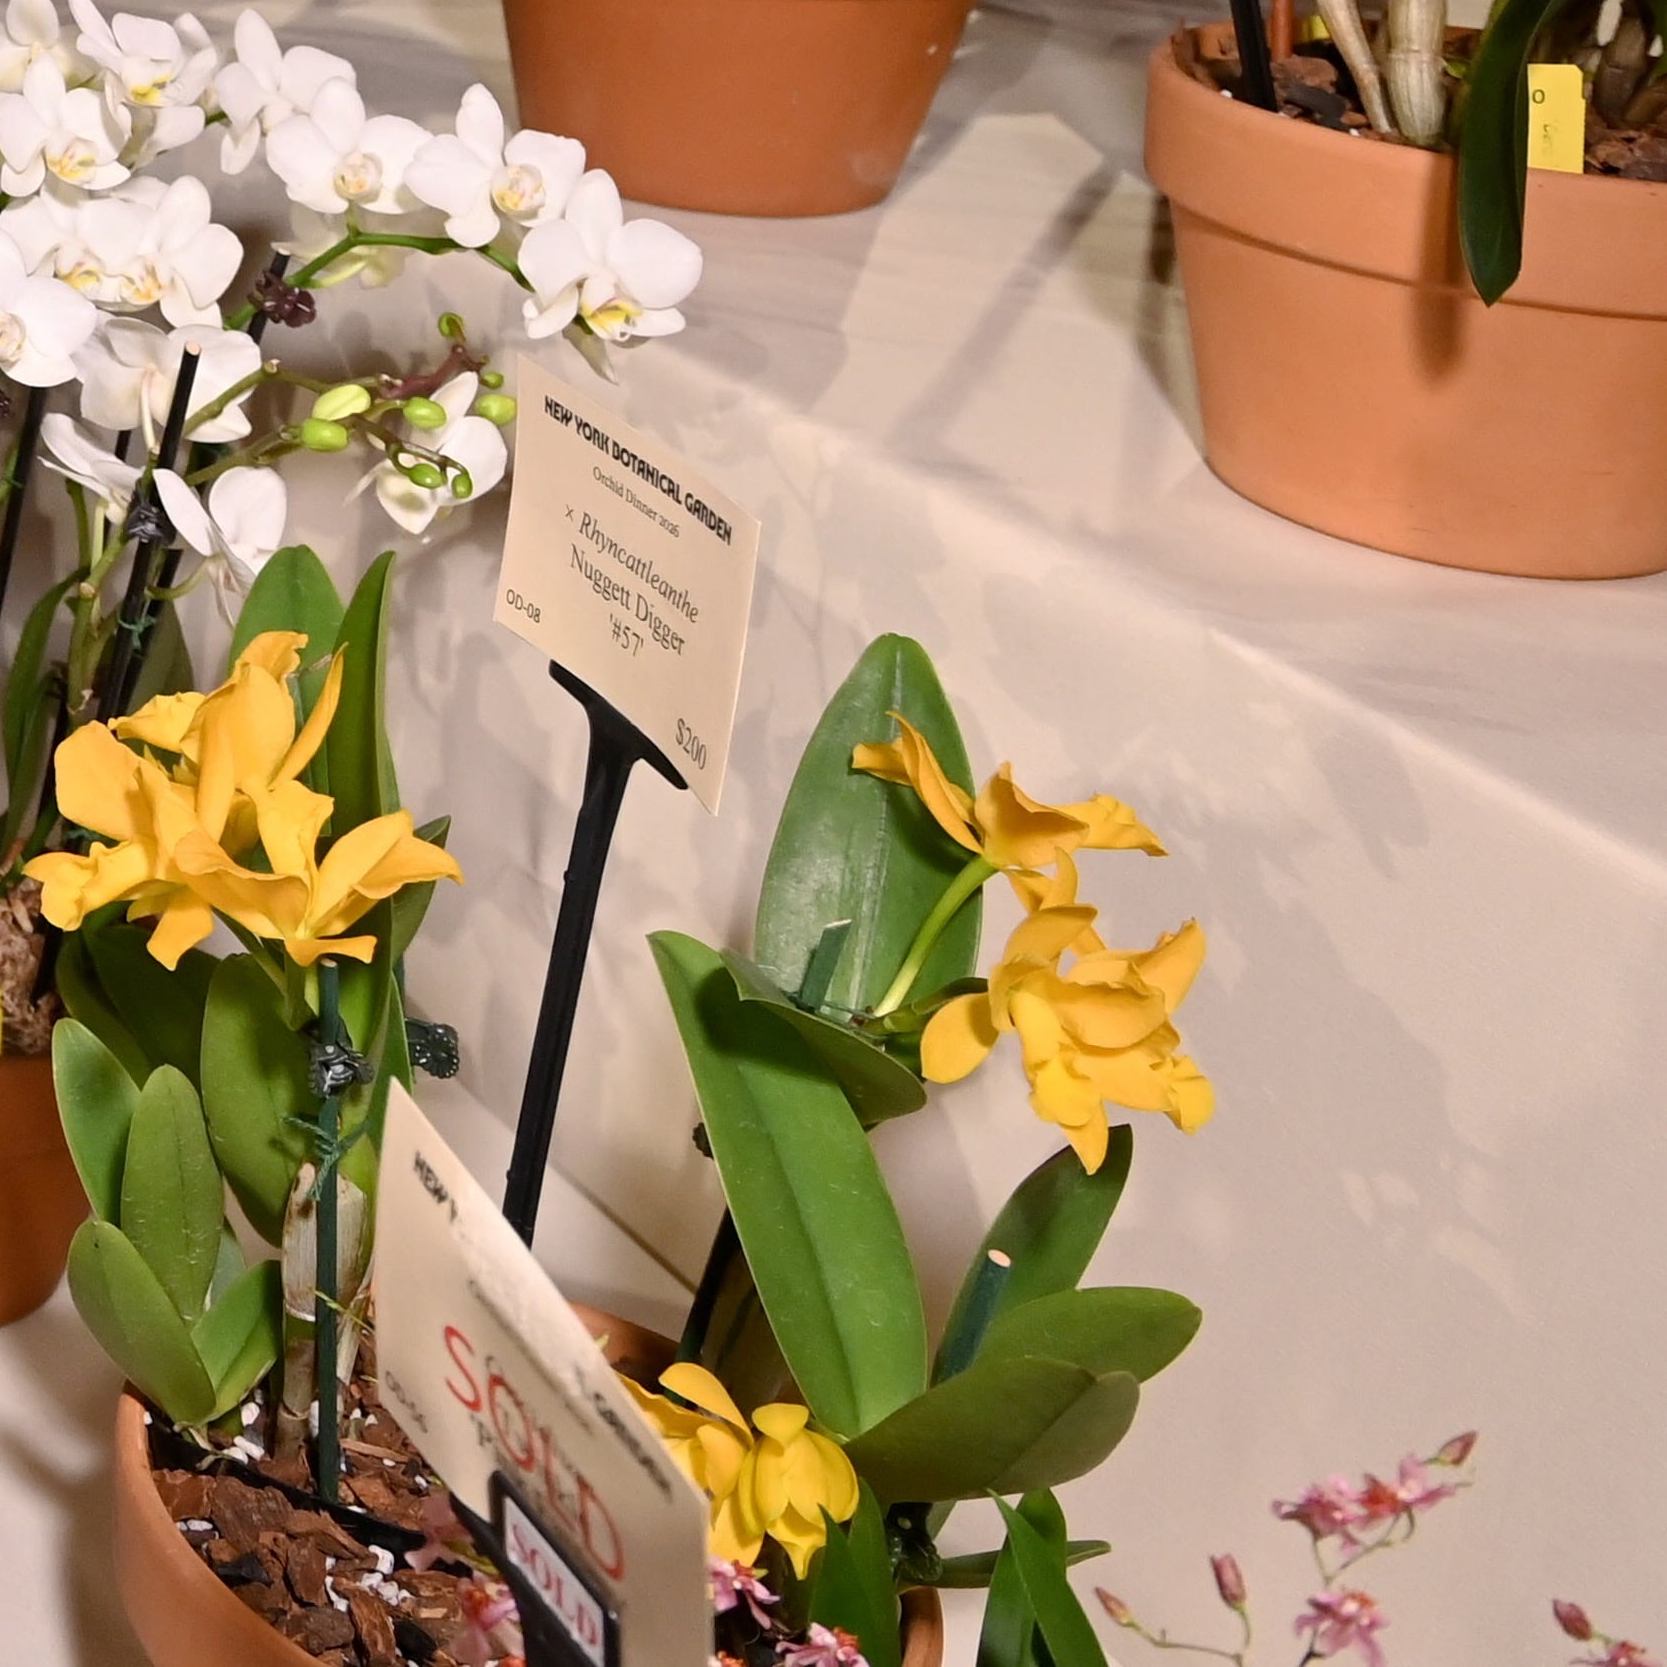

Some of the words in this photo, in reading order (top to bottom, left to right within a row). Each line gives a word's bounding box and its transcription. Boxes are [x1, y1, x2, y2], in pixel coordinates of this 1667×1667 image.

[544, 394, 573, 427] NEW
[574, 414, 611, 455] YORK
[611, 439, 683, 505] BOTANICAL
[683, 492, 733, 546] GARDEN
[593, 465, 624, 498] Orchid
[625, 488, 658, 520] Dinner
[658, 514, 681, 539] 2026
[505, 588, 542, 624] OD-08
[570, 542, 632, 611] Nuggett
[634, 592, 685, 656] Digger
[579, 511, 699, 623] Rhyncattleanthe
[674, 717, 707, 771] $200
[413, 1150, 449, 1204] NEW
[443, 1324, 625, 1582] SOLD
[511, 1523, 598, 1647] SOLD
